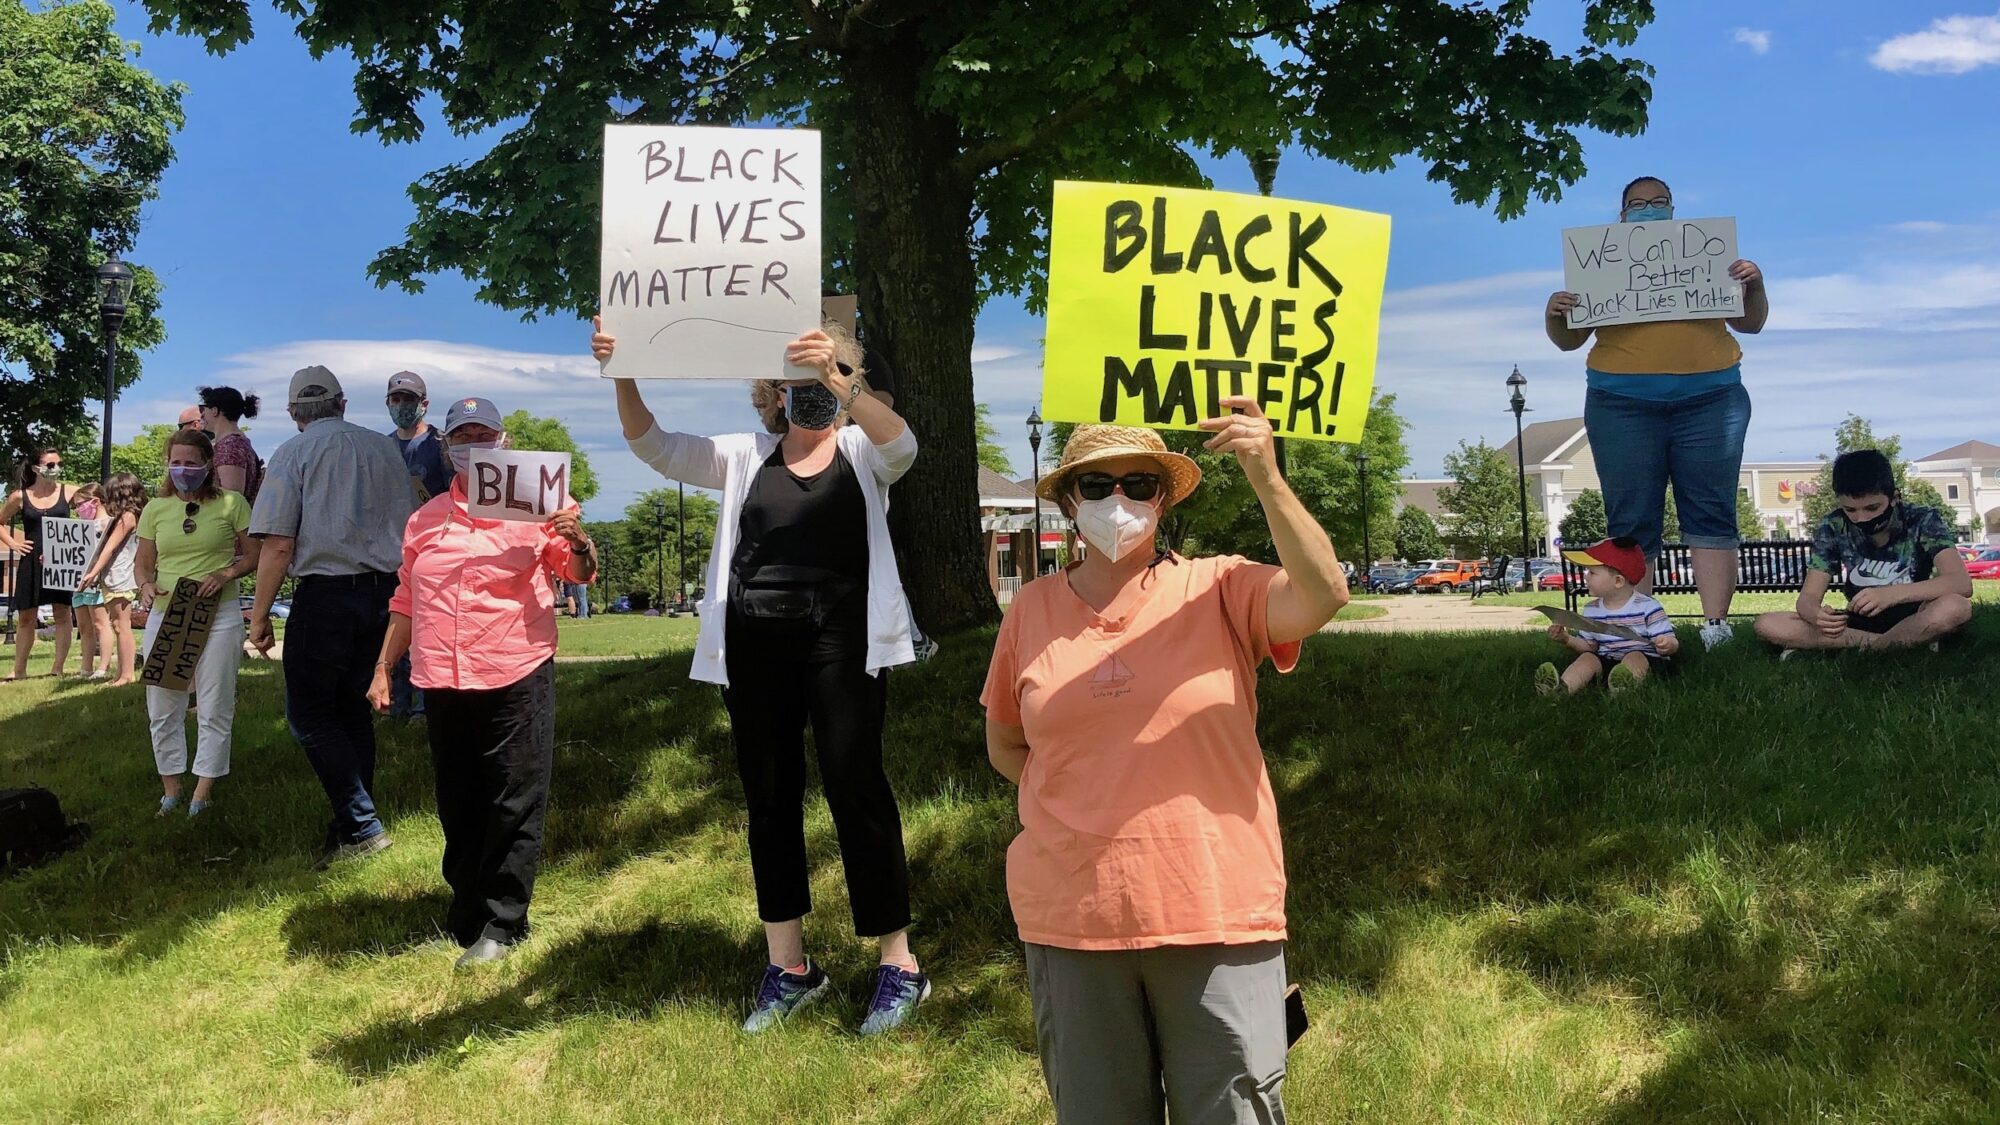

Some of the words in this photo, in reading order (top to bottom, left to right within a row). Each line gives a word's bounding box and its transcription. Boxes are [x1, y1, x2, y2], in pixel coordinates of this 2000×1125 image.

[638, 140, 805, 190] BLACK
[653, 198, 806, 244] LIVES
[1103, 197, 1343, 297] BLACK
[1568, 227, 1623, 270] We
[1628, 225, 1675, 262] Can
[1682, 223, 1726, 259] Do
[607, 261, 797, 308] MATTER
[1625, 260, 1711, 292] Better!
[1139, 285, 1338, 370] LIVES
[1569, 293, 1630, 324] Black
[1635, 292, 1677, 312] Lives
[1685, 287, 1739, 310] Matter
[1100, 356, 1345, 436] MATTER!
[475, 461, 565, 516] BLM
[46, 520, 91, 546] BLACK
[52, 545, 86, 566] LIVES
[43, 567, 82, 588] MATTE
